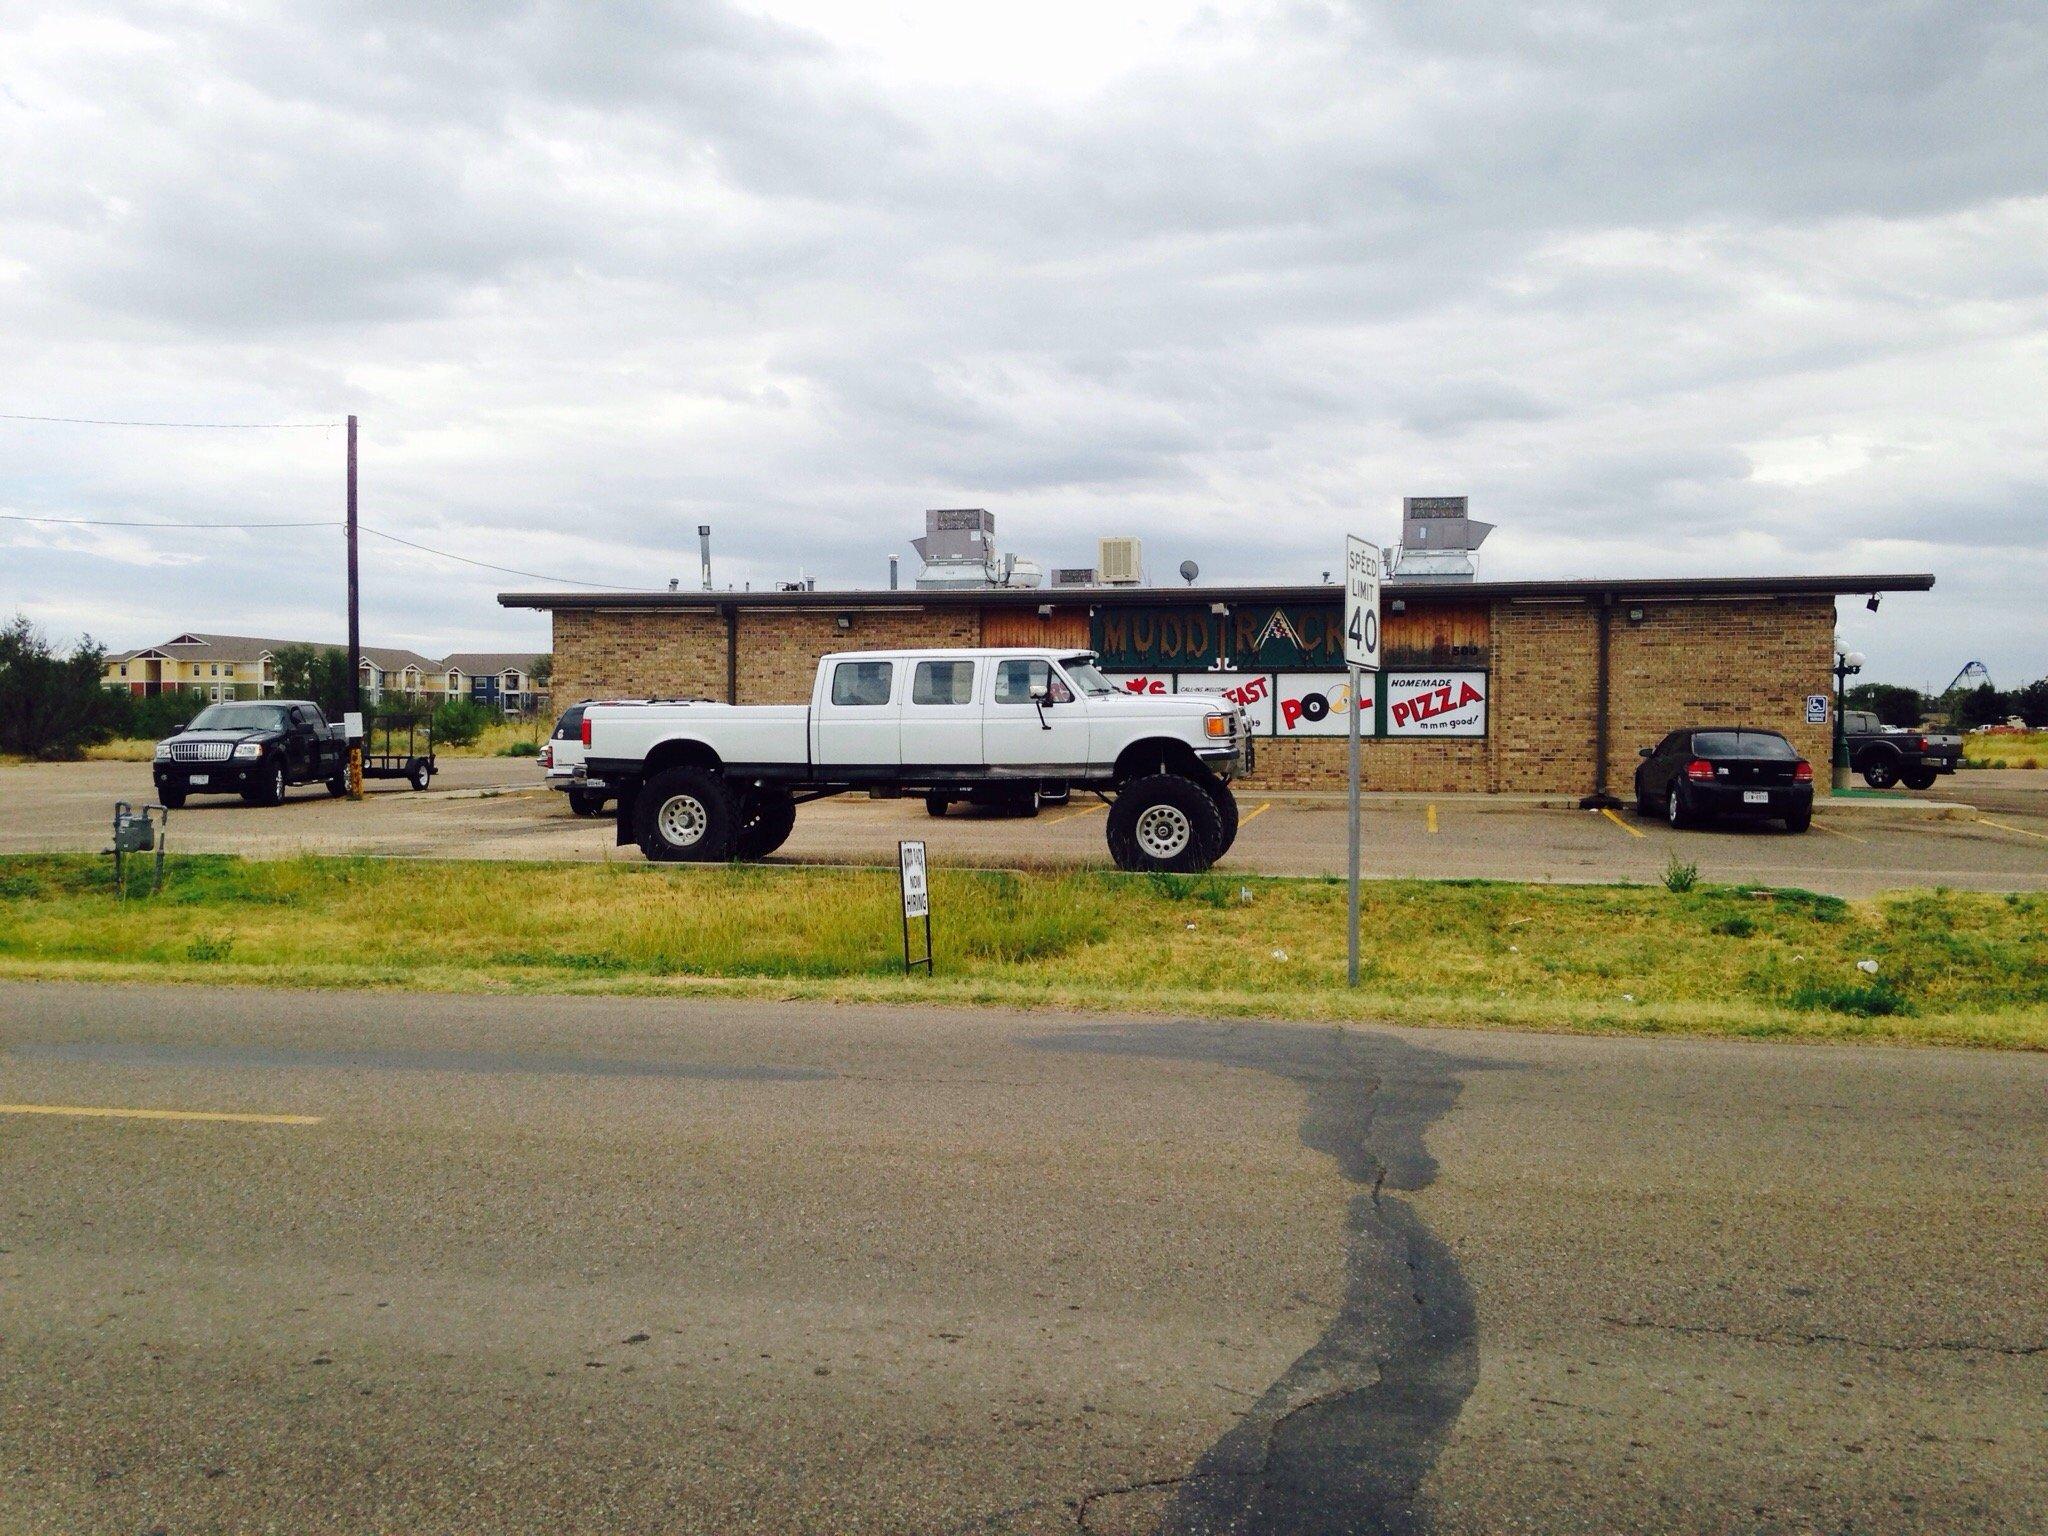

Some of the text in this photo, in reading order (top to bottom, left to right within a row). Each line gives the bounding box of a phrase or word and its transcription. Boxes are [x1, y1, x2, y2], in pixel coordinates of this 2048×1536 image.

[1349, 550, 1376, 577] SPEED
[1352, 577, 1374, 602] LIMIT
[1104, 611, 1208, 658] MUDD
[1348, 606, 1377, 654] 40
[1222, 677, 1268, 706] FAST
[1391, 679, 1452, 687] HOMEMADE
[1391, 681, 1485, 728] PIZZA
[1449, 715, 1479, 729] good!
[910, 875, 921, 888] NOW
[907, 893, 926, 912] HIRING
